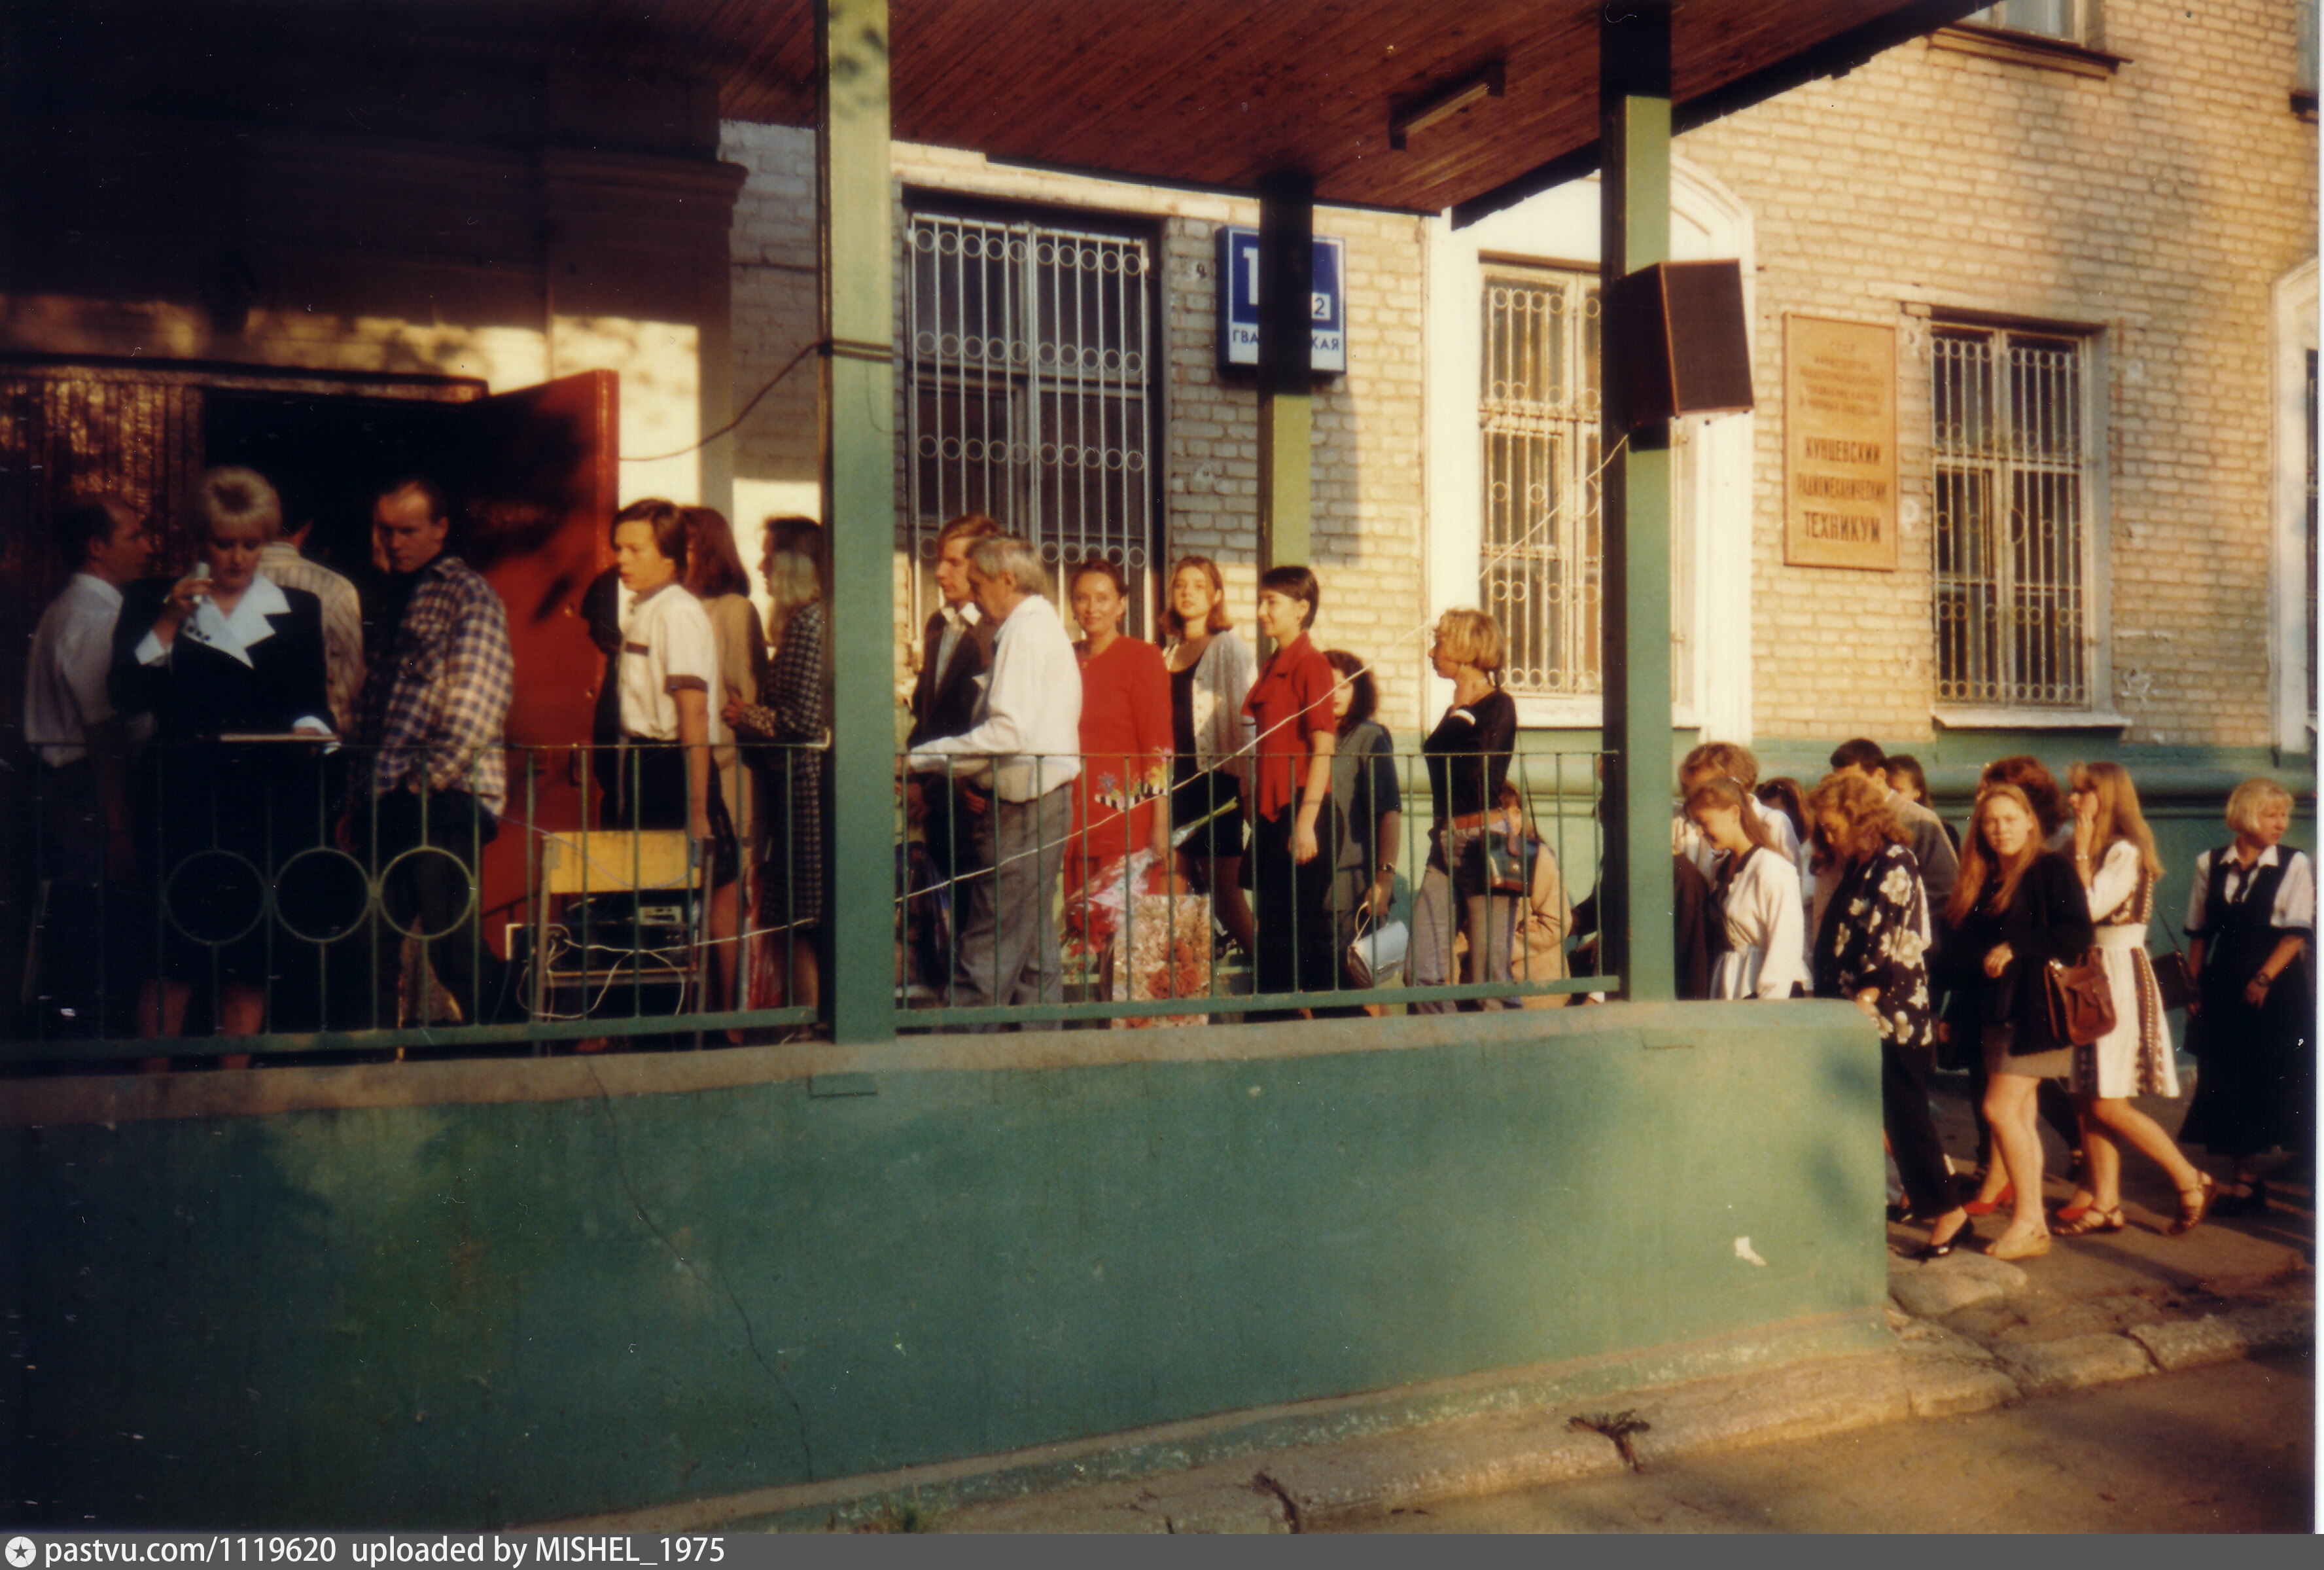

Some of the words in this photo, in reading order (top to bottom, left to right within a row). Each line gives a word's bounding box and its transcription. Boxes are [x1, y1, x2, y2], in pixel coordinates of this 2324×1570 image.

[1314, 296, 1326, 316] 2
[1233, 329, 1339, 351] ГВАКАЯ
[1804, 511, 1881, 544] ТЕХНИКУМ
